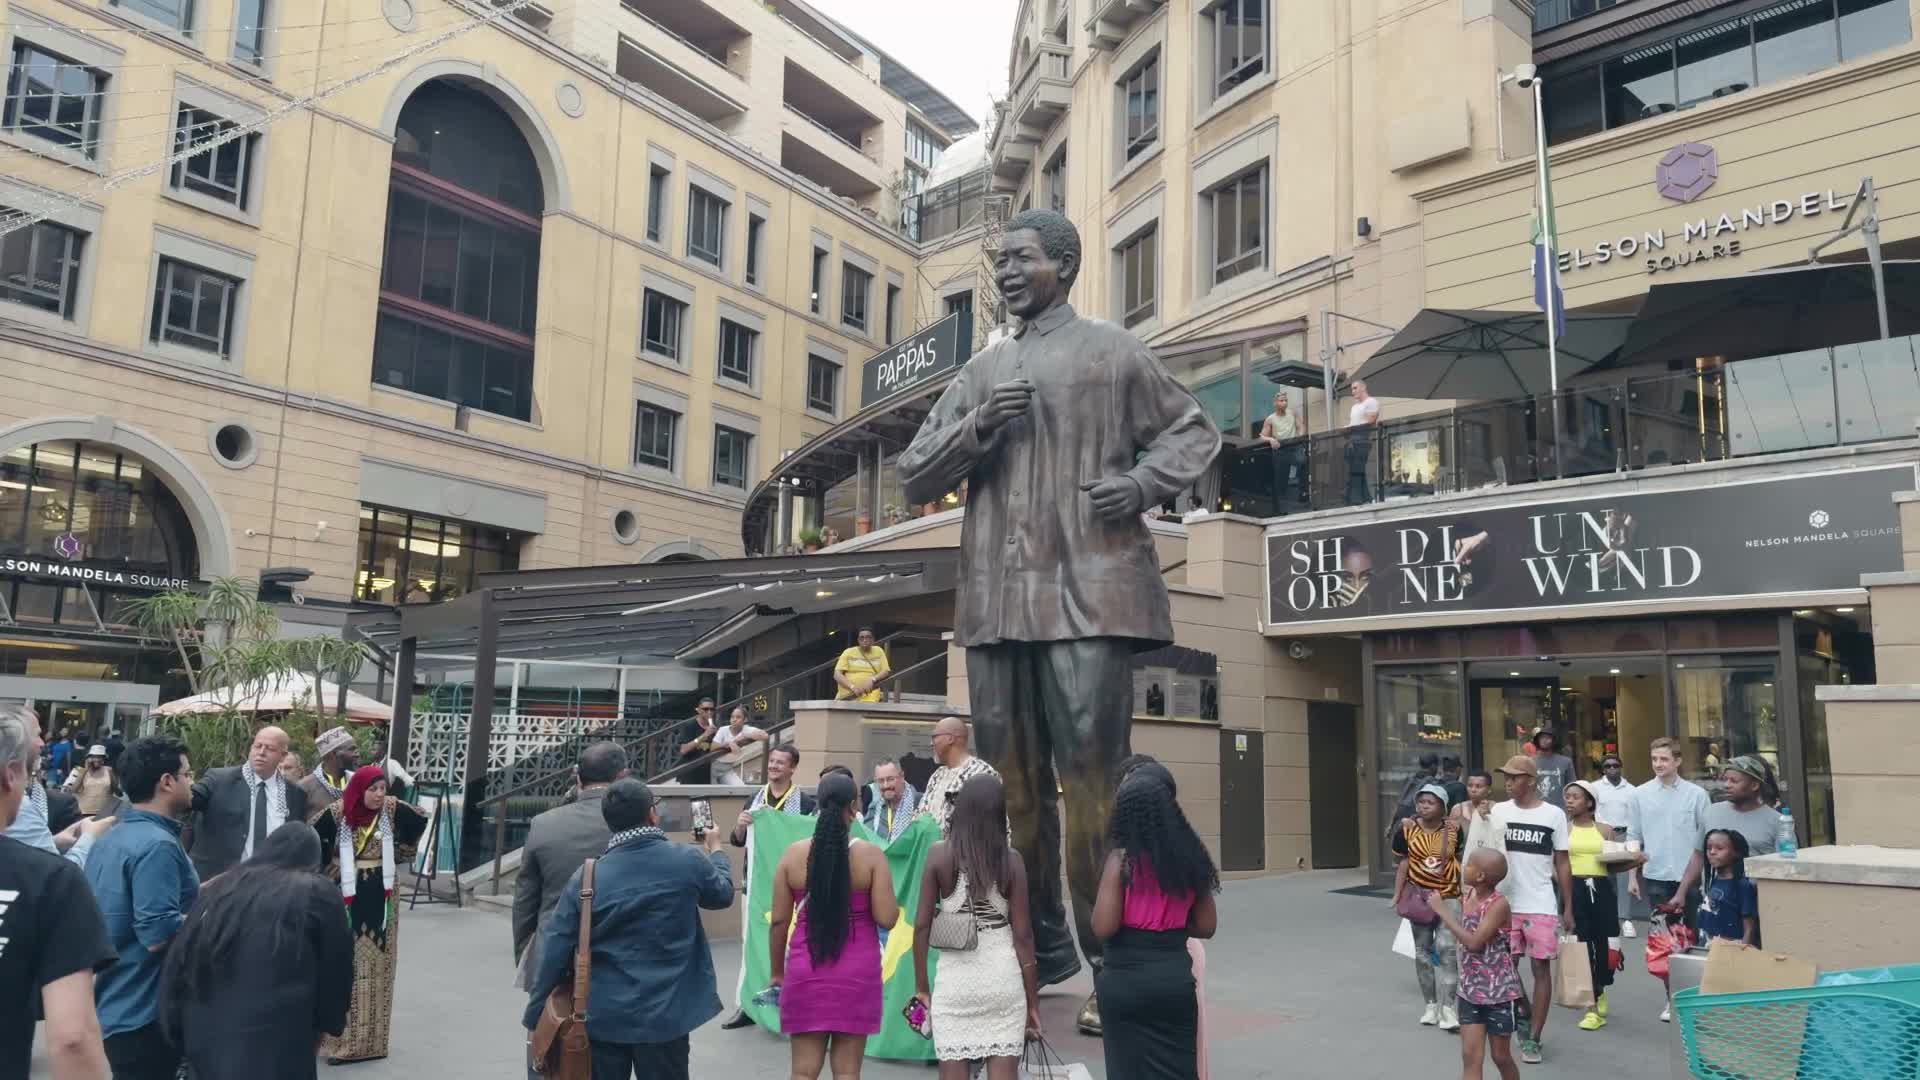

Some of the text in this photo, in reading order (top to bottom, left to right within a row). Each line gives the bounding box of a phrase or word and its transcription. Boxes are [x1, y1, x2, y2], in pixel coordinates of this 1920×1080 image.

[1684, 187, 1878, 243] MANDEL
[1646, 240, 1742, 274] SQUARE
[877, 337, 936, 391] PAPPAS
[1396, 525, 1456, 566] DI
[1528, 509, 1615, 554] UN
[1745, 526, 1904, 548] NELSON MANDELA SQUARE
[1290, 536, 1345, 575] SH
[1520, 545, 1702, 597] WIND
[48, 564, 124, 583] MANDELA
[130, 574, 189, 590] SQUARE
[1288, 574, 1342, 611] OP
[1400, 564, 1464, 604] NE
[1505, 828, 1545, 843] REDBAT
